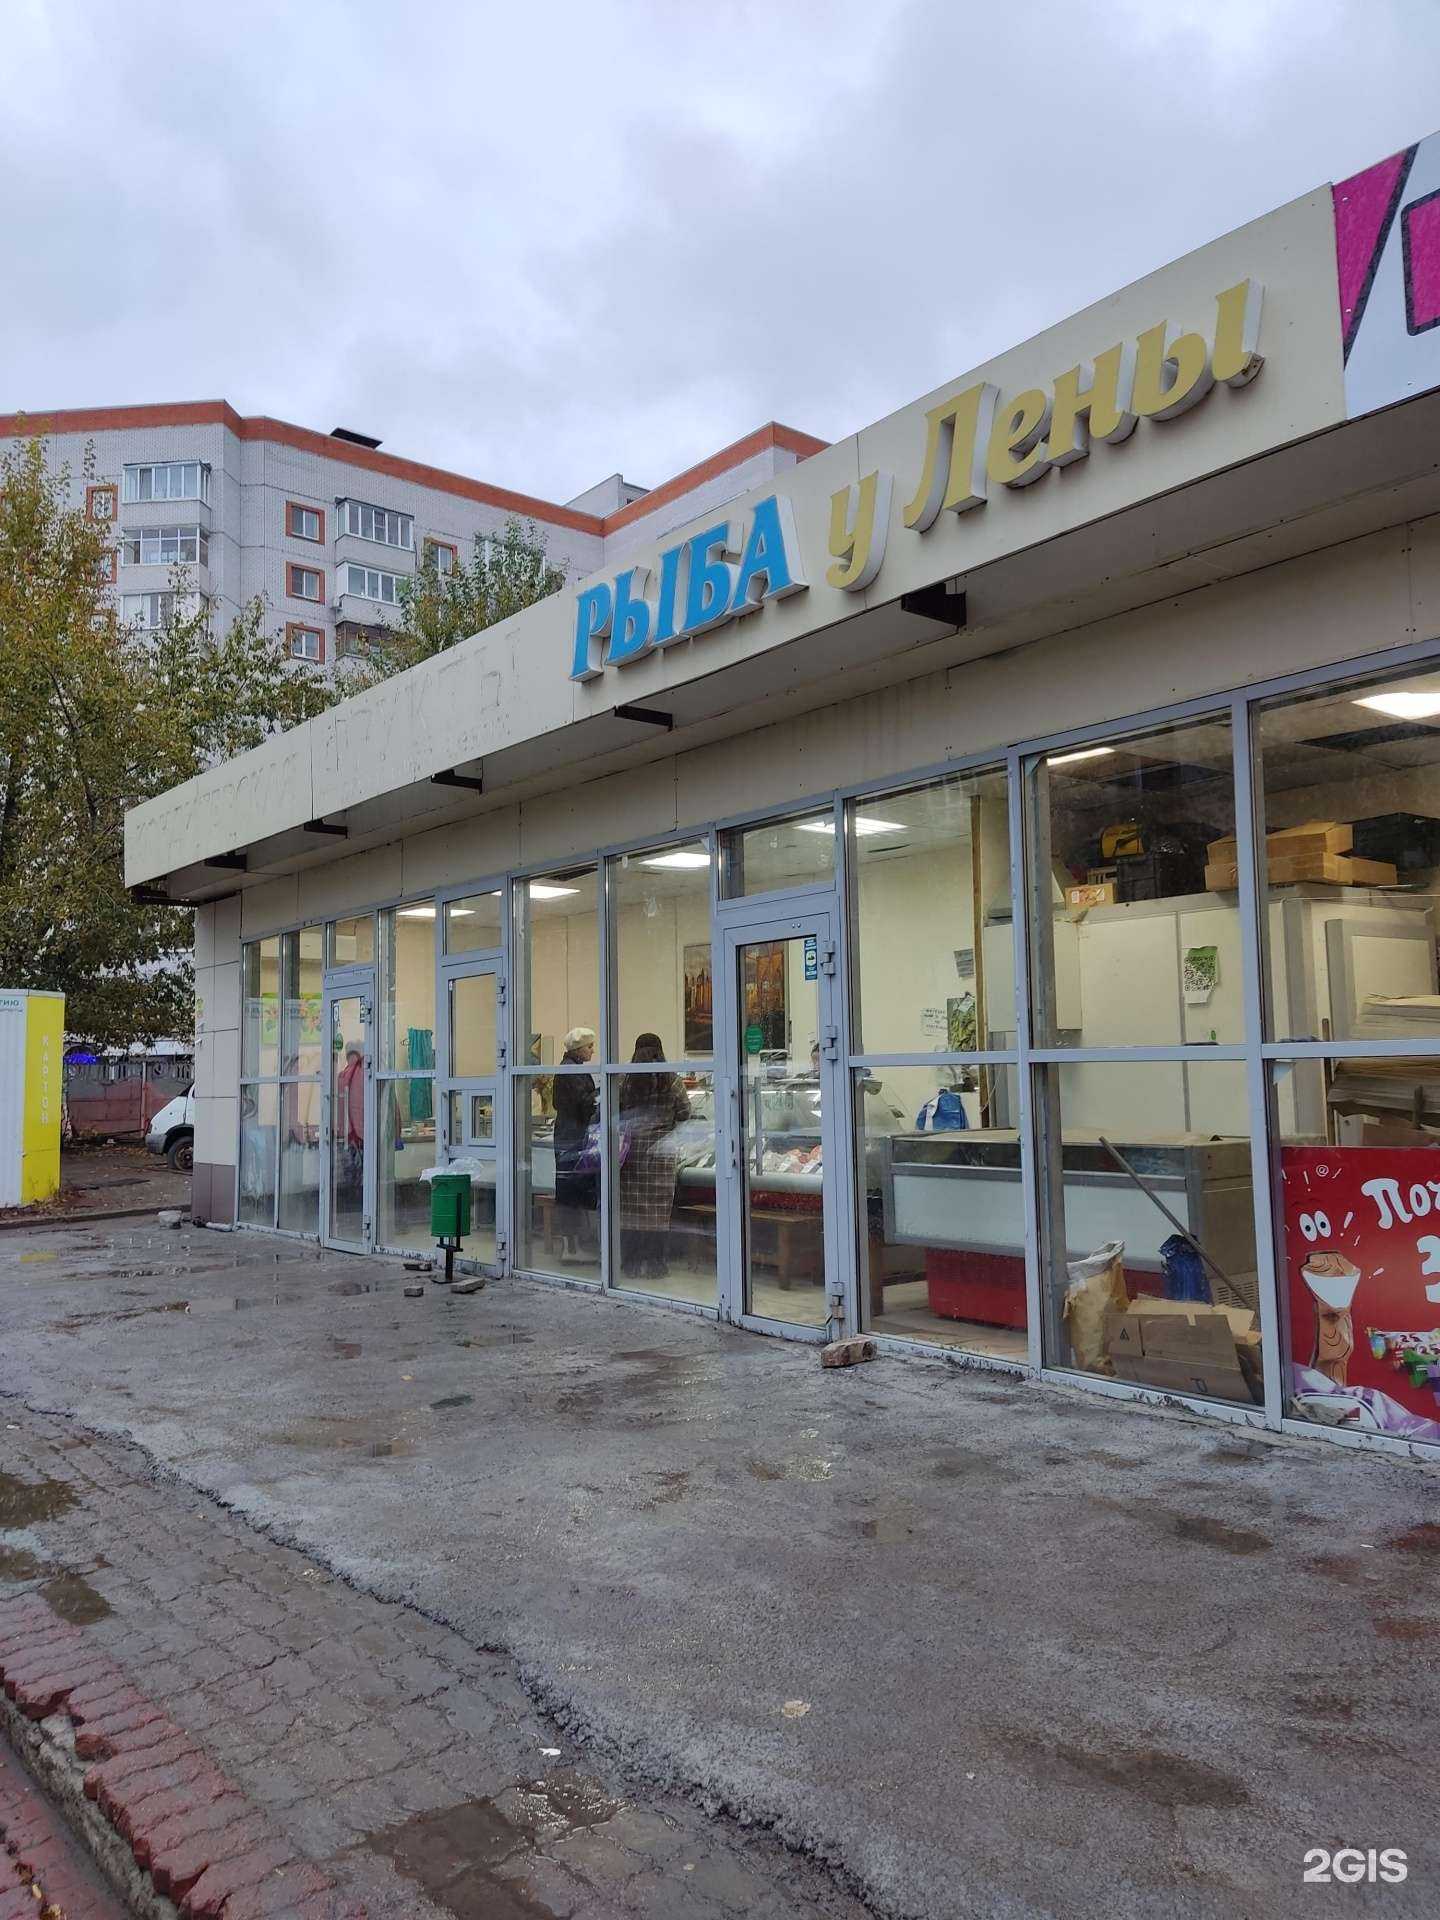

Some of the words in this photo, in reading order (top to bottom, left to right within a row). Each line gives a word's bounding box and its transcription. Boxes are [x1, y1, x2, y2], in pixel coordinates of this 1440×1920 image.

[571, 495, 807, 682] РЫБА
[826, 470, 890, 592] у
[904, 279, 1264, 533] Лены
